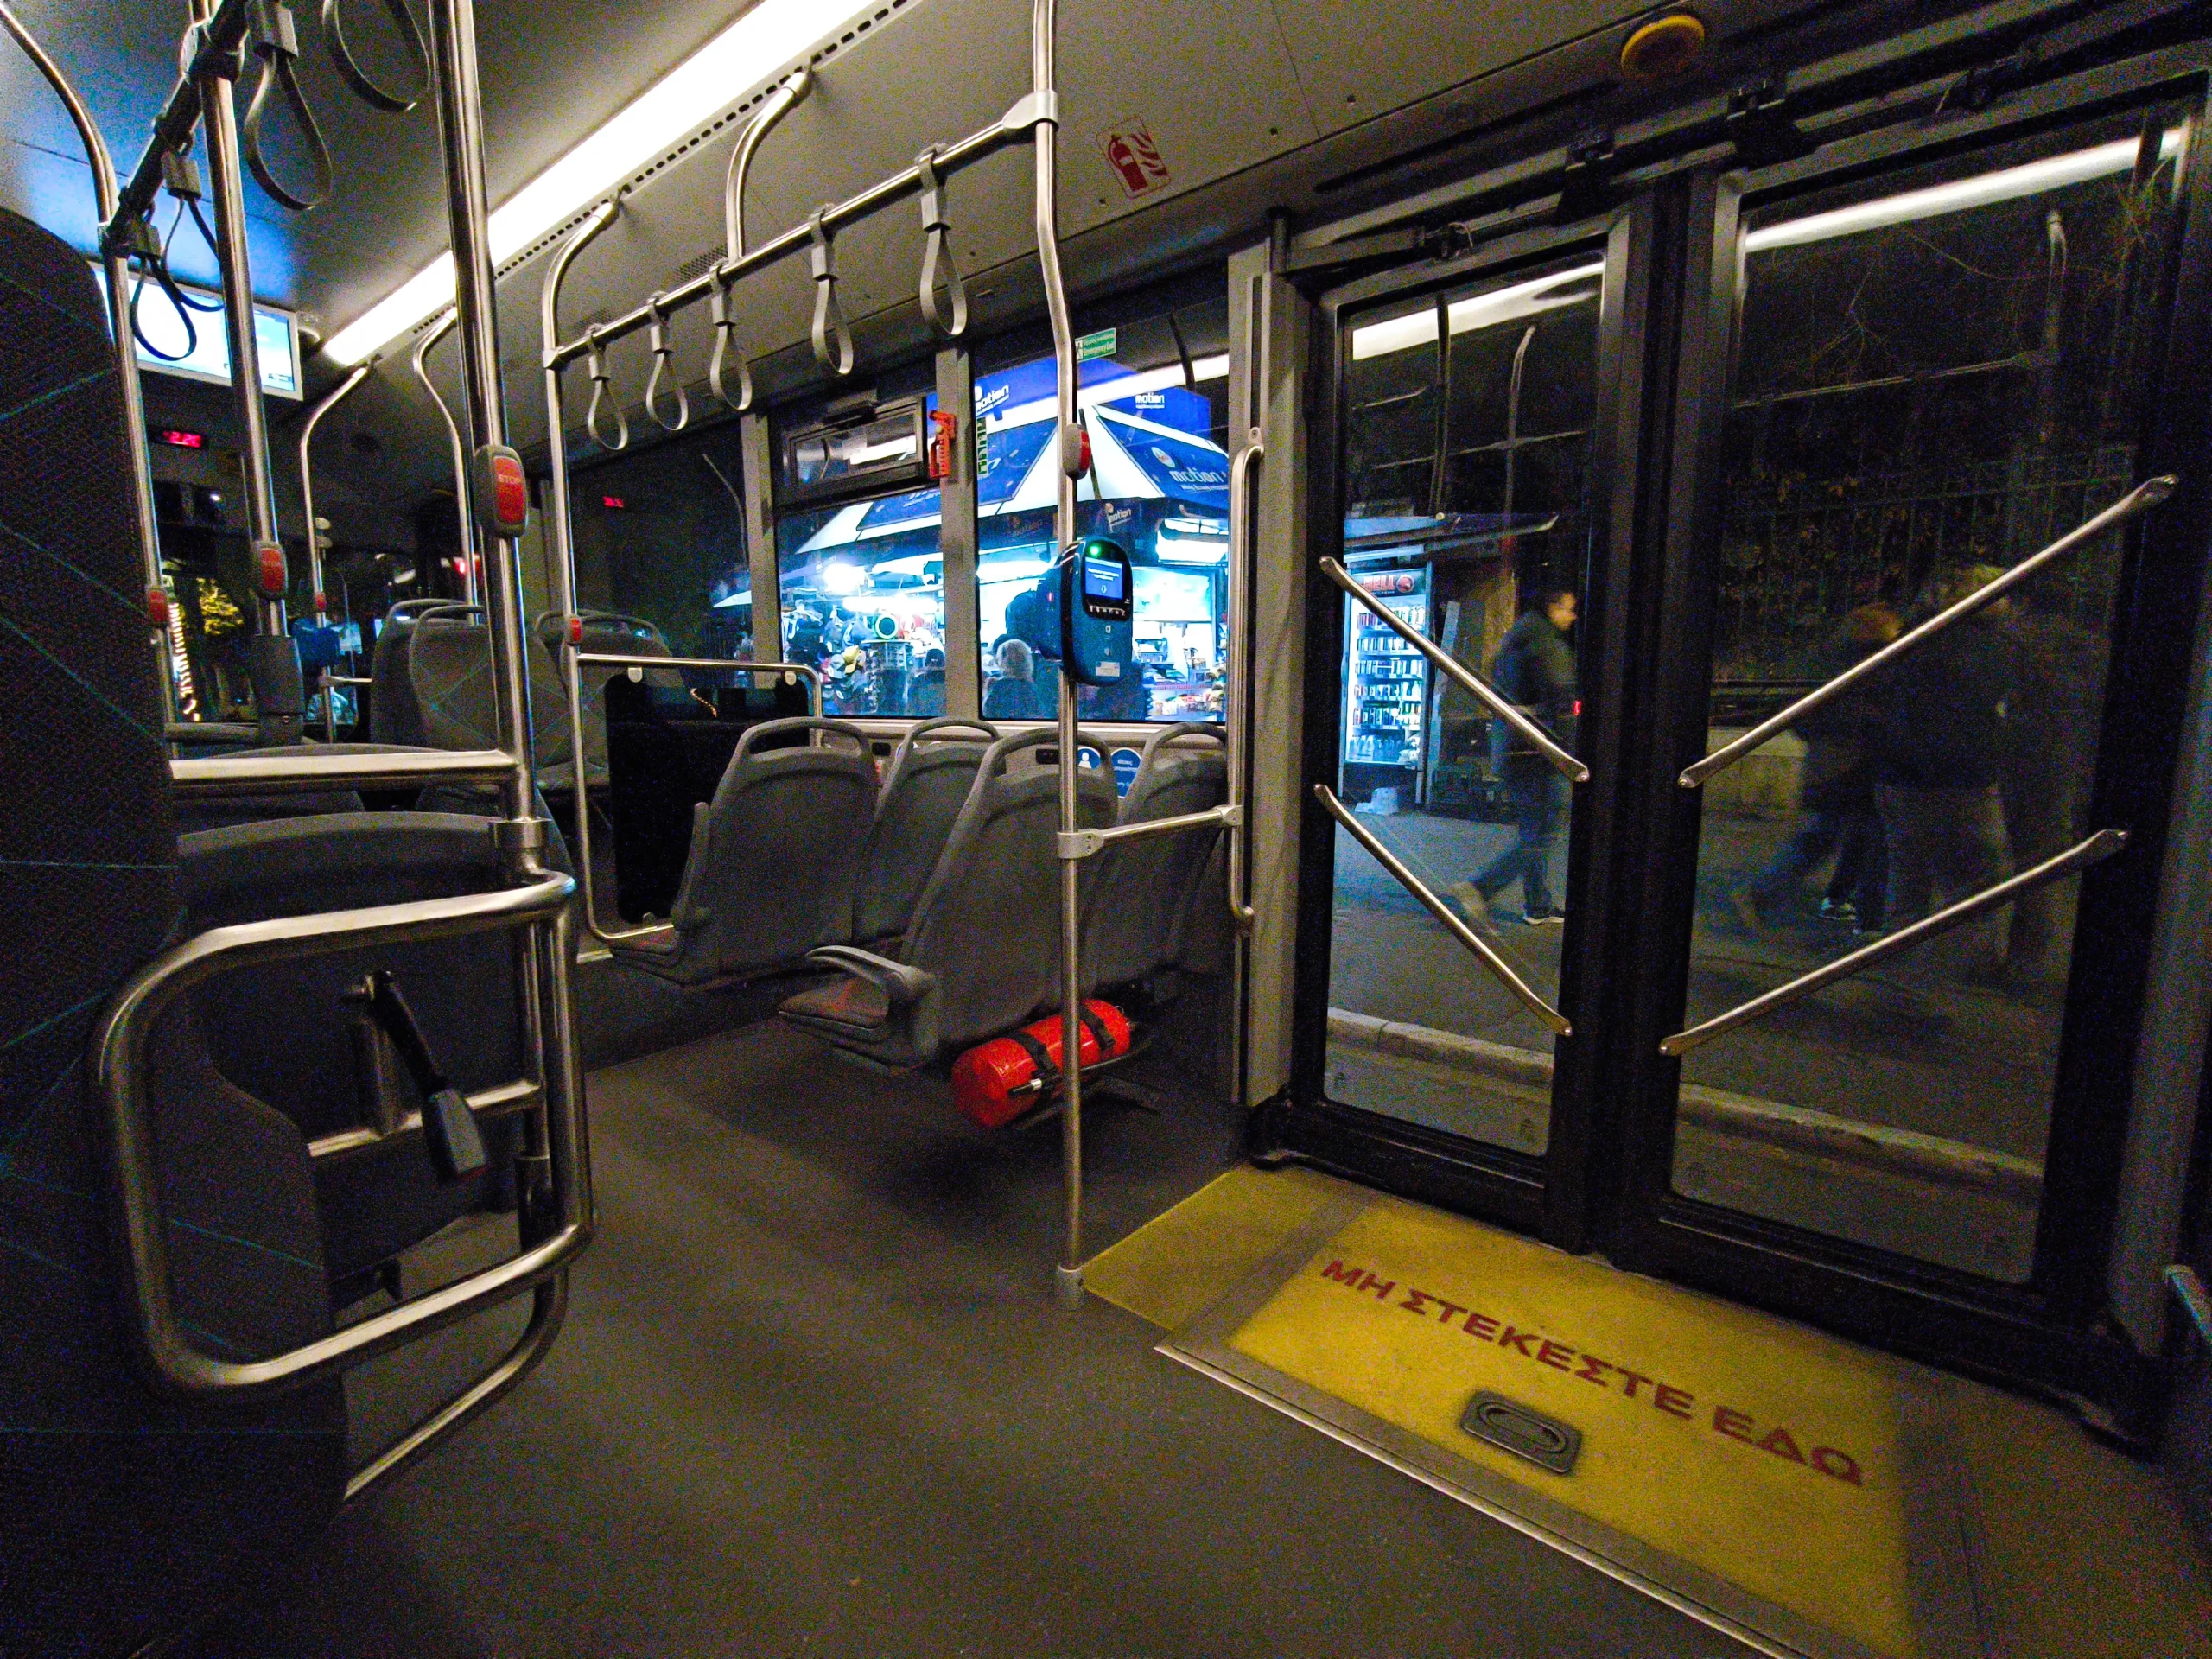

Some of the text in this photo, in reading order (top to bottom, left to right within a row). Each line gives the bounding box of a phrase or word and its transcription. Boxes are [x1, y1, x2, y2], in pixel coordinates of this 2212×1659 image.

[1135, 392, 1165, 404] motion
[498, 474, 522, 484] STOP
[1169, 467, 1224, 482] motion
[1321, 1259, 1864, 1486] ΜΗ ΣΤΕΚΕΣΤΕ ΕΔΩ
